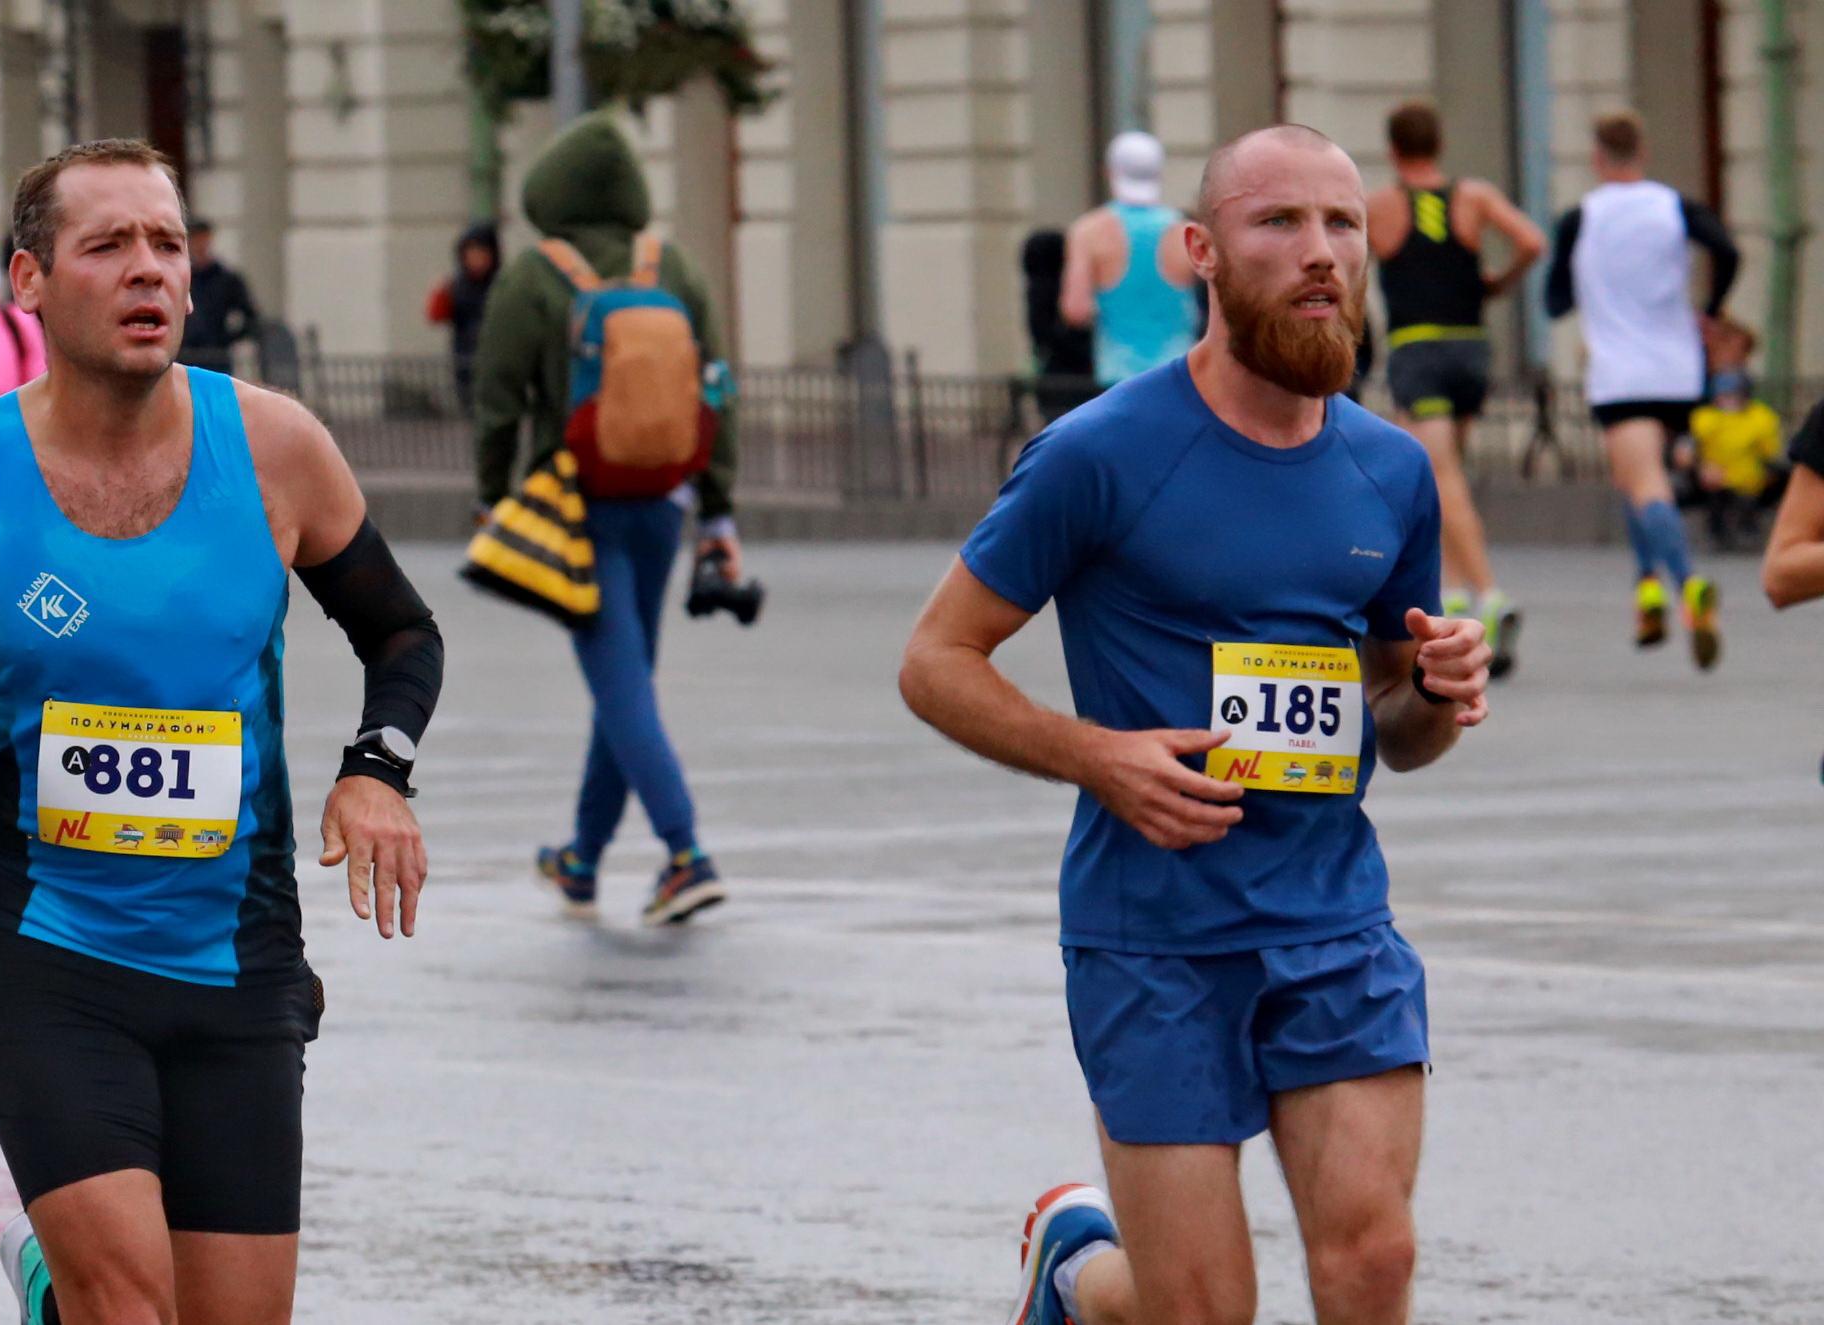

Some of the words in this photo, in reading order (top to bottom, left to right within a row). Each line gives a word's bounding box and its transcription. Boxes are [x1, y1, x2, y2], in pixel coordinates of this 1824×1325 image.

[16, 572, 49, 608] KALINA
[63, 609, 90, 637] TEAM
[71, 717, 205, 734] ПОЛУМАРАФОН
[1256, 683, 1341, 737] 185
[1288, 738, 1317, 748] ПАВЕЛ
[84, 744, 195, 799] 881
[1224, 751, 1262, 783] NL
[55, 811, 91, 843] NL
